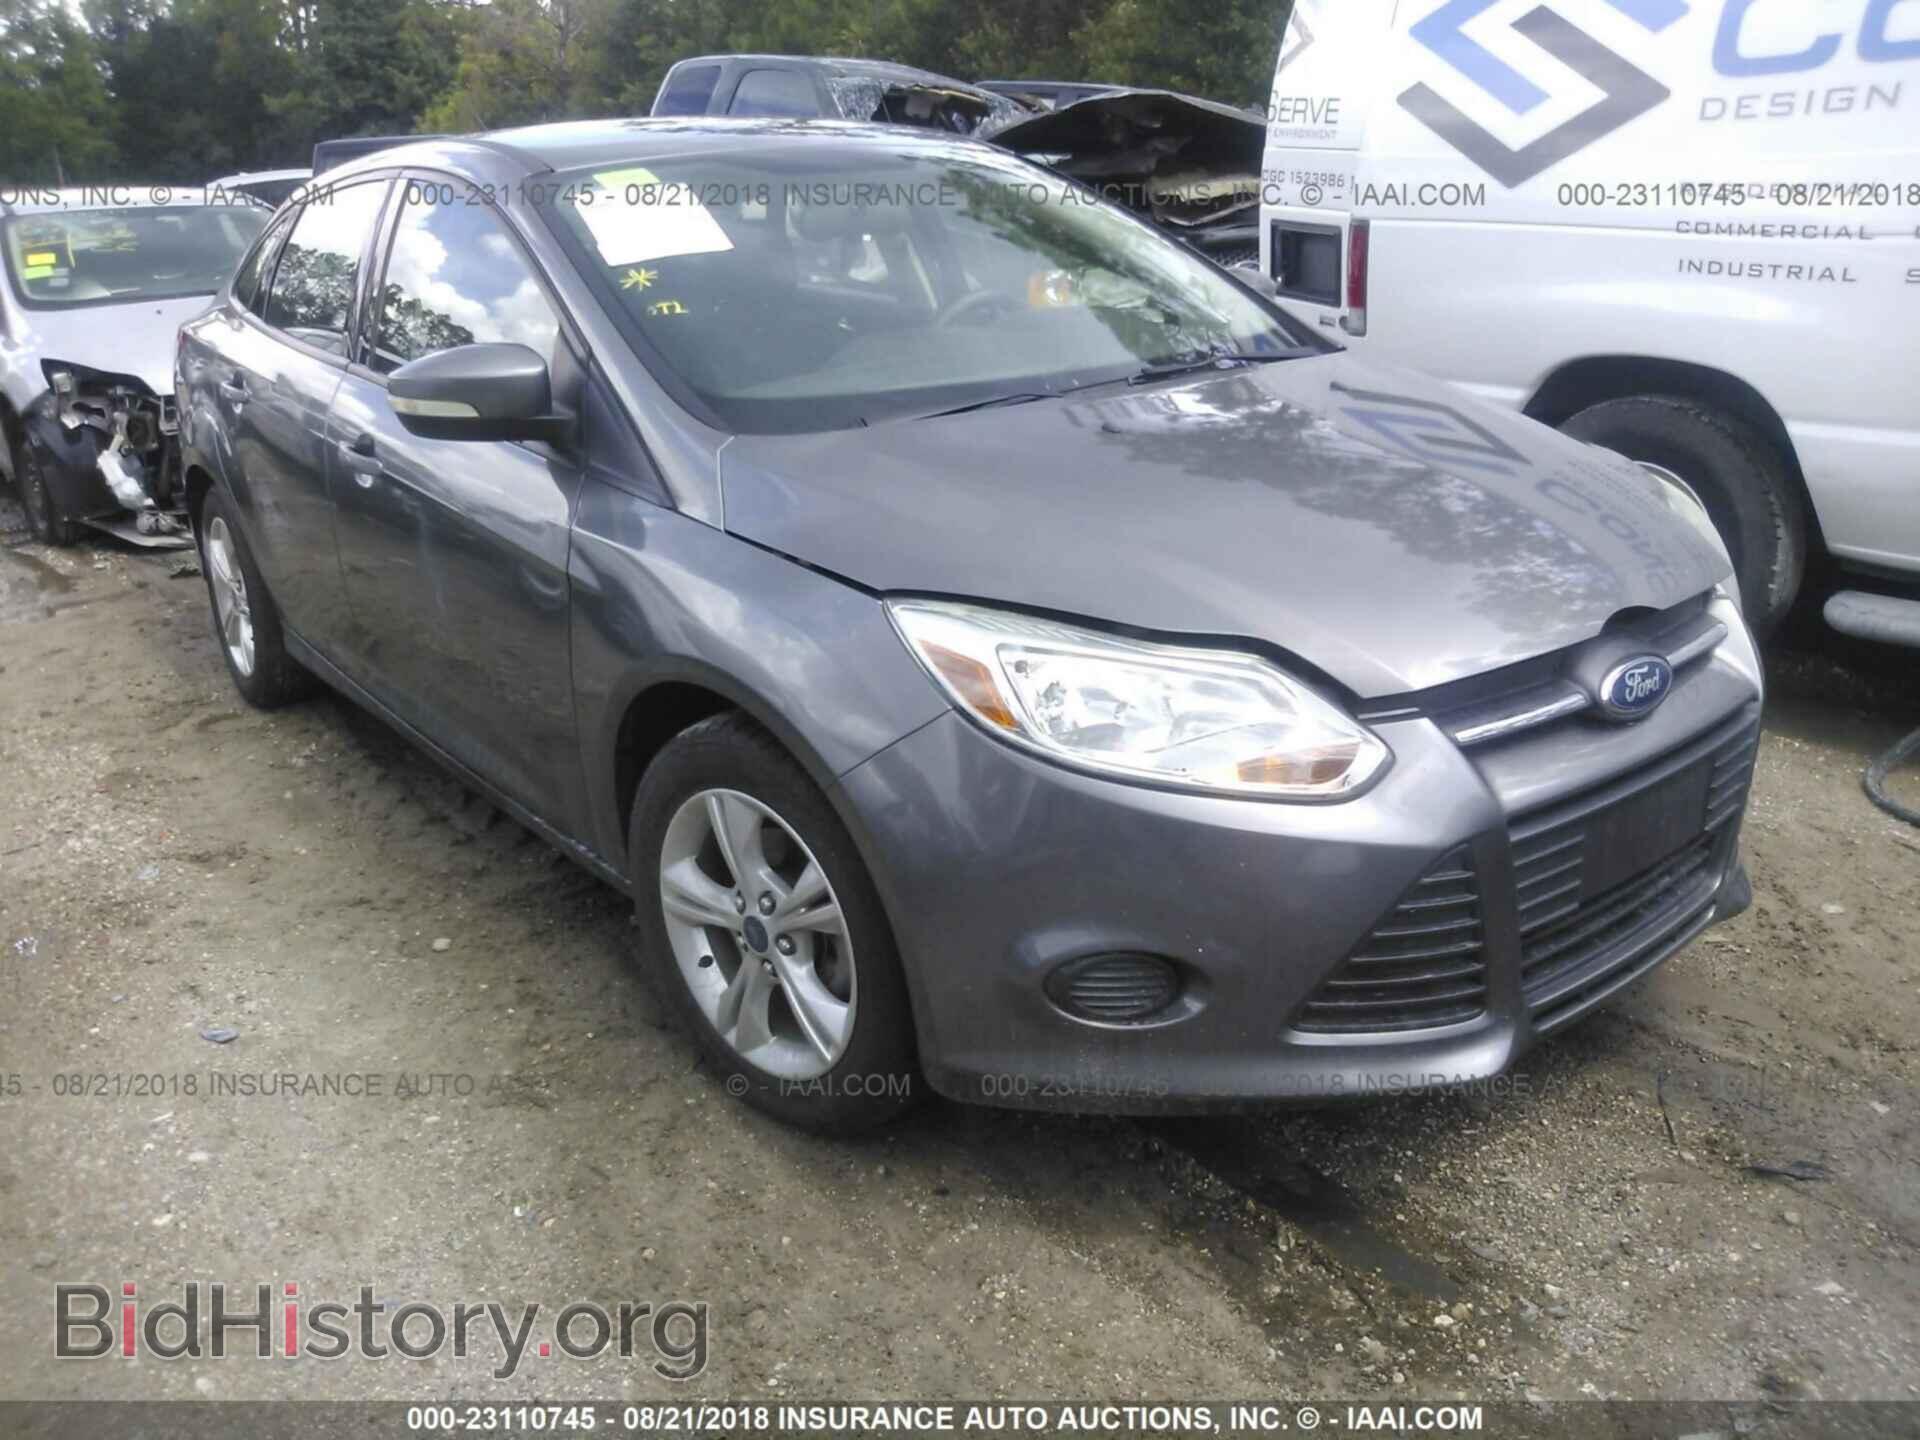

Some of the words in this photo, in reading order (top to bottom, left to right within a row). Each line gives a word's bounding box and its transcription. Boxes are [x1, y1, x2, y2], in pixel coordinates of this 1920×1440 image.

[1699, 81, 1903, 121] DESIGN
[1675, 219, 1874, 241] COMMERCIAL
[1678, 257, 1857, 282] INDUSTRIAL
[1624, 665, 1661, 703] Ford
